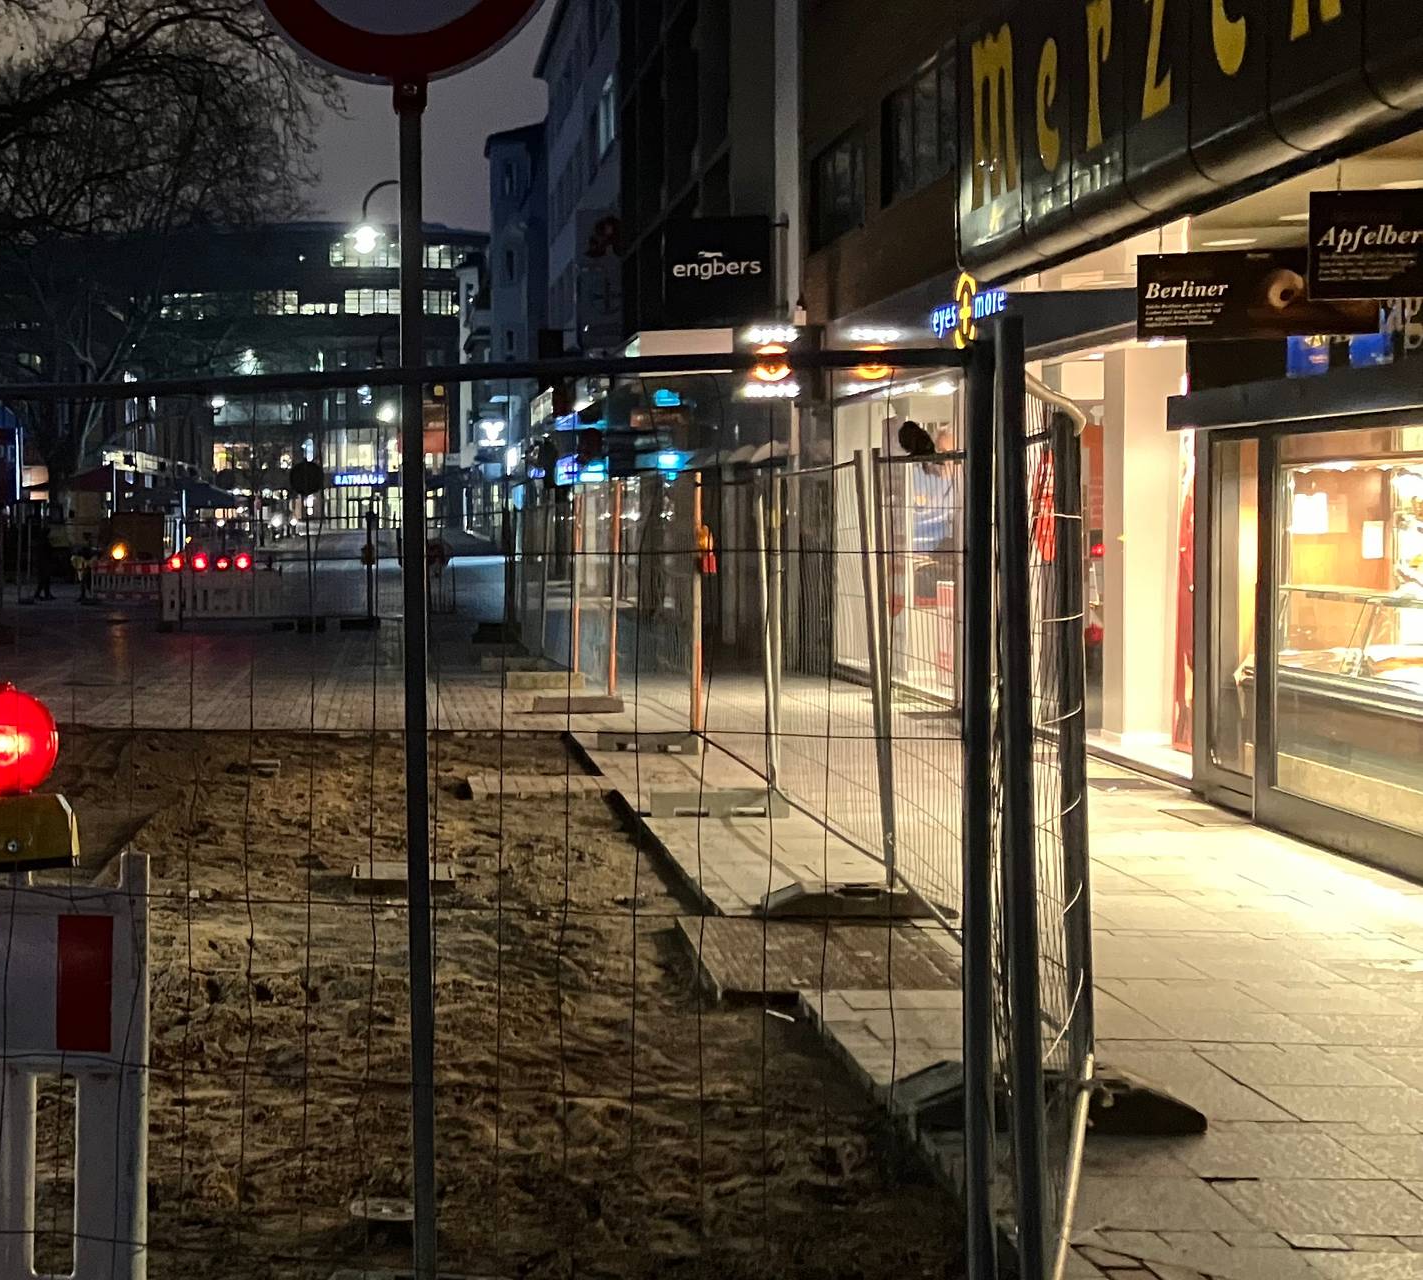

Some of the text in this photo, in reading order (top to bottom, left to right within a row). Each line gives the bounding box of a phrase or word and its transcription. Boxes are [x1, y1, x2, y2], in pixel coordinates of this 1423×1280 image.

[1317, 224, 1423, 253] Apfelber
[672, 258, 762, 280] engbers
[1145, 280, 1229, 299] Berliner
[933, 305, 956, 339] eyes
[974, 291, 1005, 319] more
[334, 473, 386, 485] RATHAUS
